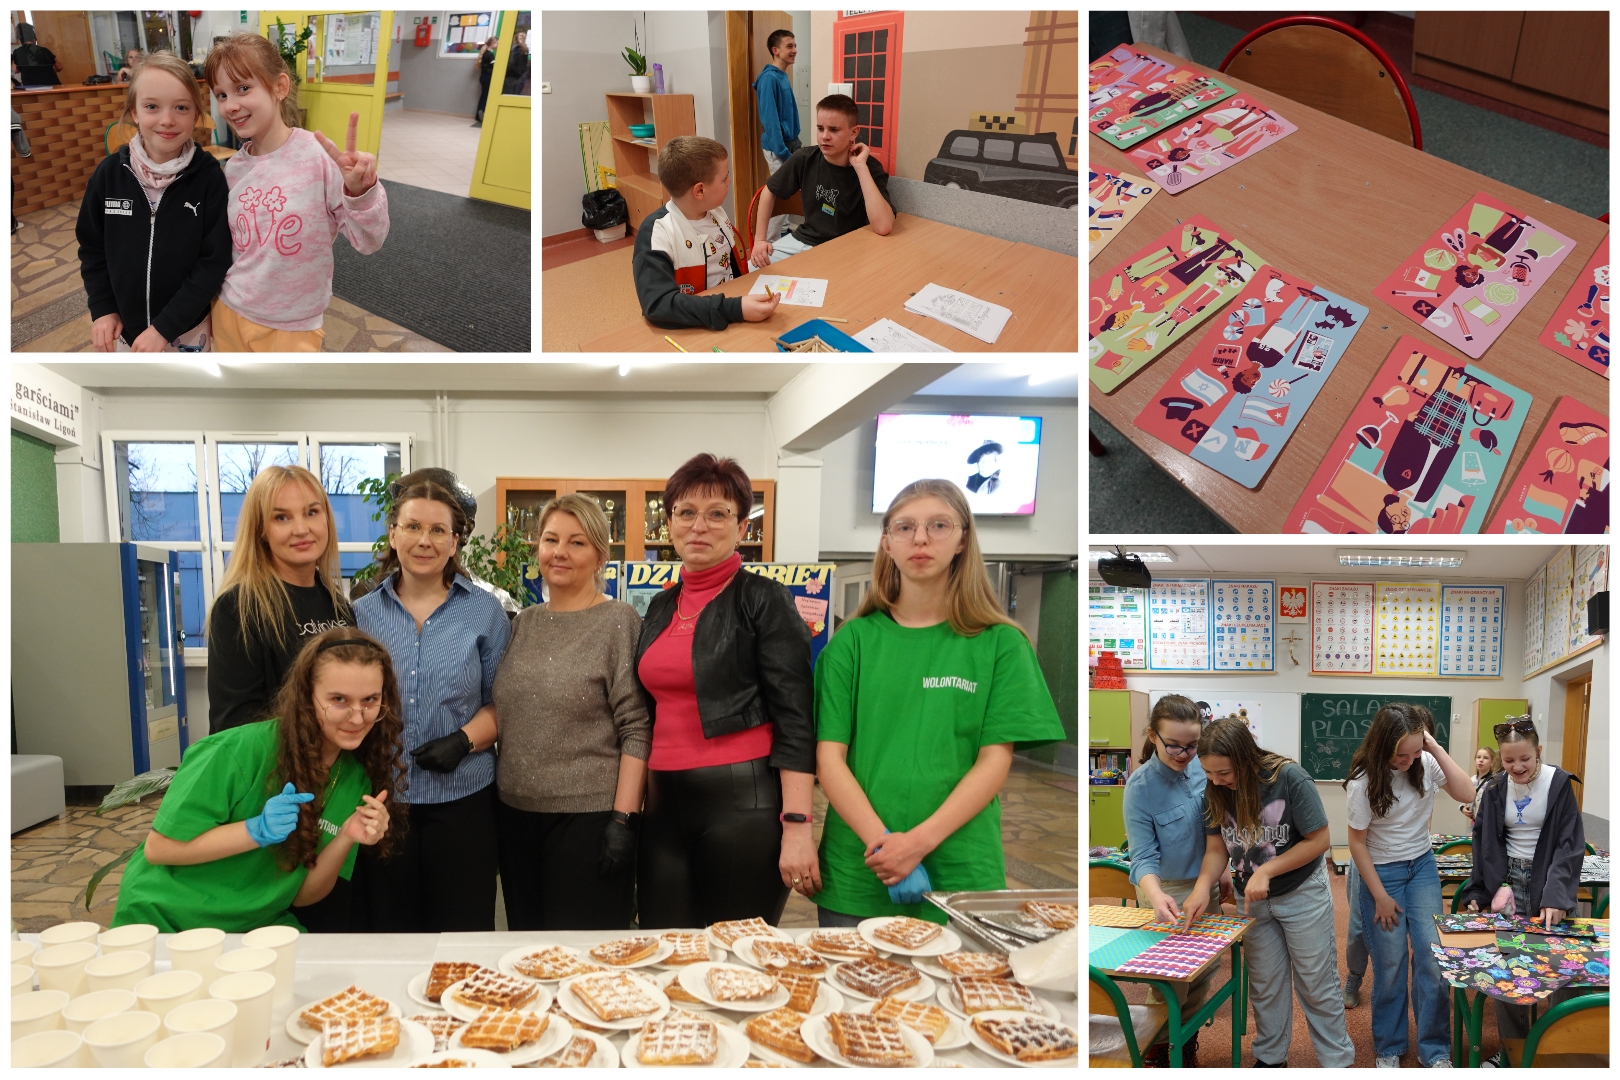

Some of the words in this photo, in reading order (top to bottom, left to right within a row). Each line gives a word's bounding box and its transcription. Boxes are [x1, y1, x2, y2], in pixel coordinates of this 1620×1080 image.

[231, 203, 303, 257] ove
[54, 418, 76, 438] Ligoń
[628, 564, 683, 586] DZI
[744, 564, 836, 586] OBIET
[922, 676, 978, 694] WOLONTARIAT
[1322, 699, 1382, 717] SALA
